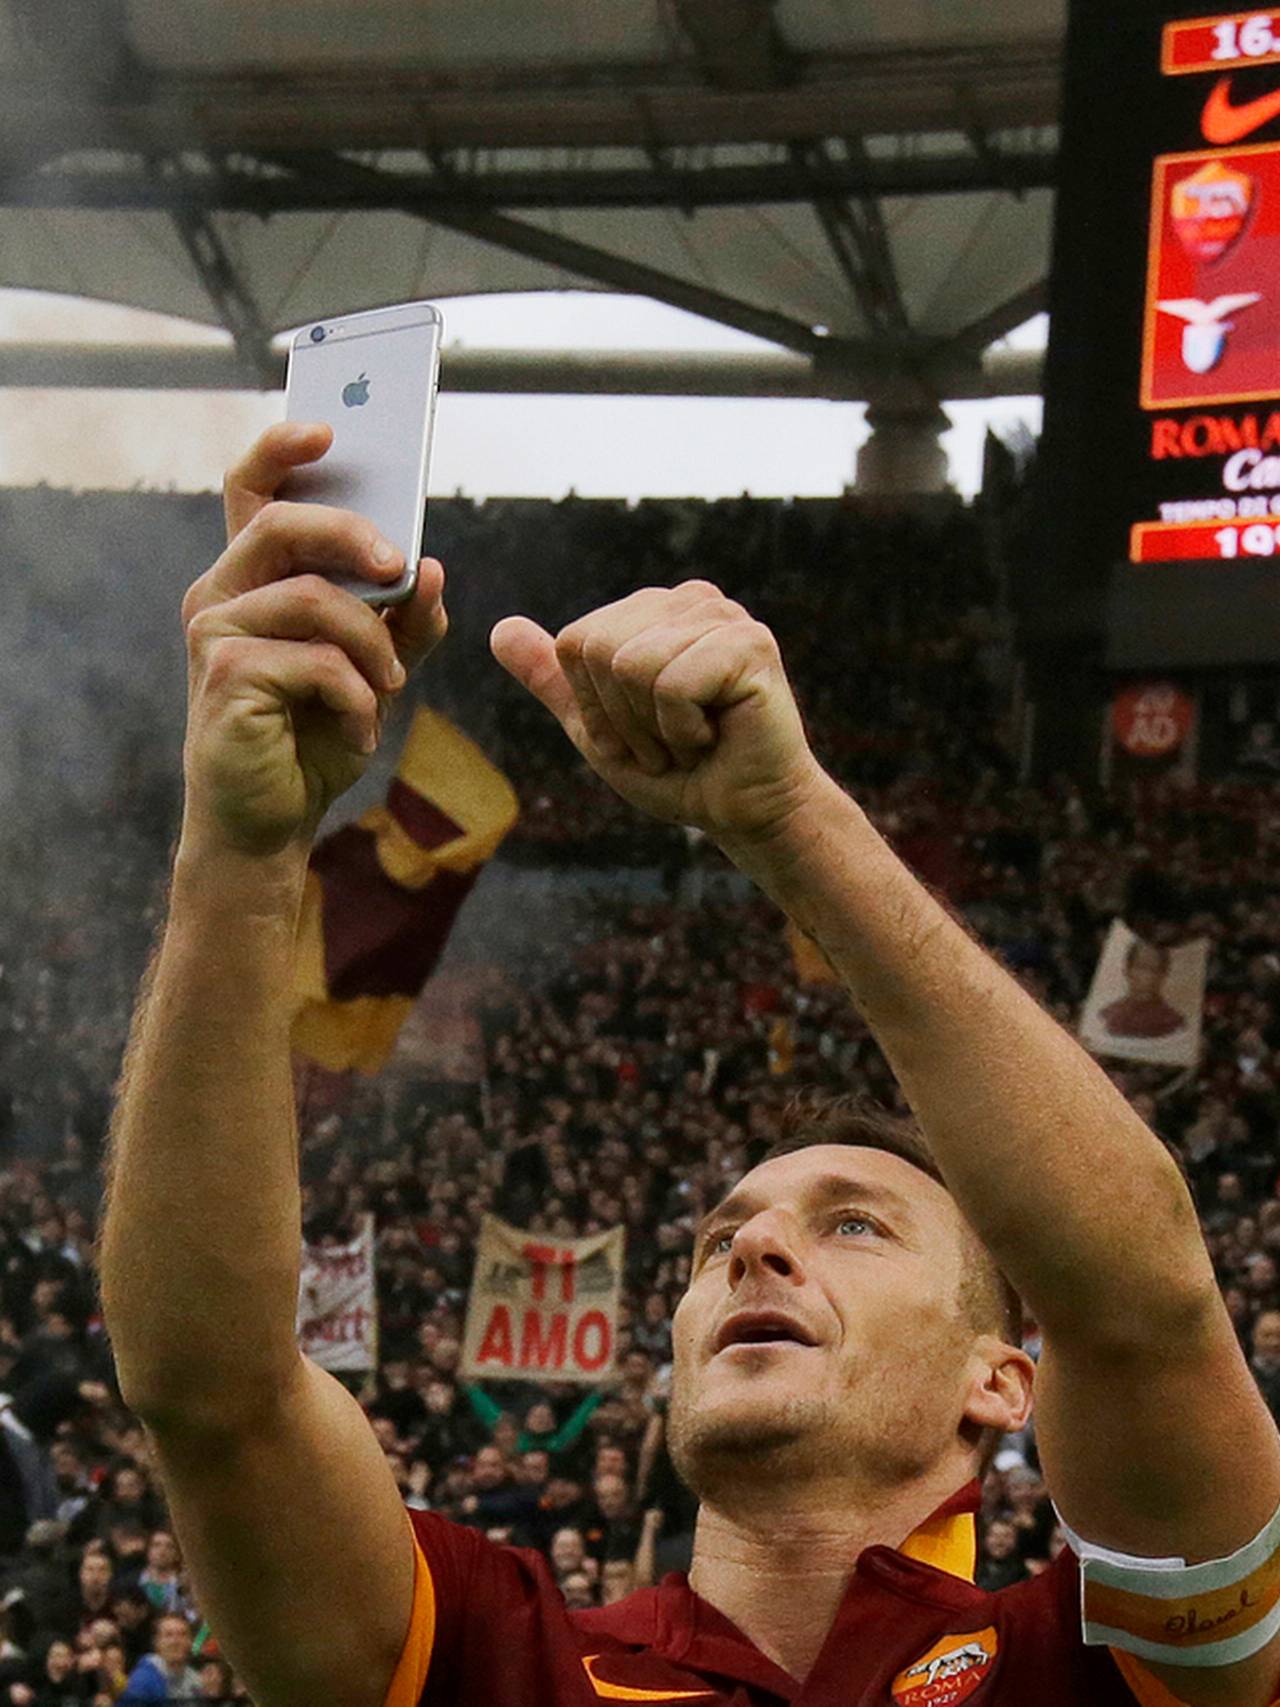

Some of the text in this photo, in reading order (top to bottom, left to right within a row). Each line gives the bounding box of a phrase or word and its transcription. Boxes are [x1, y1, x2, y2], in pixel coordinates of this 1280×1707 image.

[522, 1243, 576, 1302] TI
[476, 1304, 611, 1371] AMO
[904, 1671, 981, 1706] ROMA
